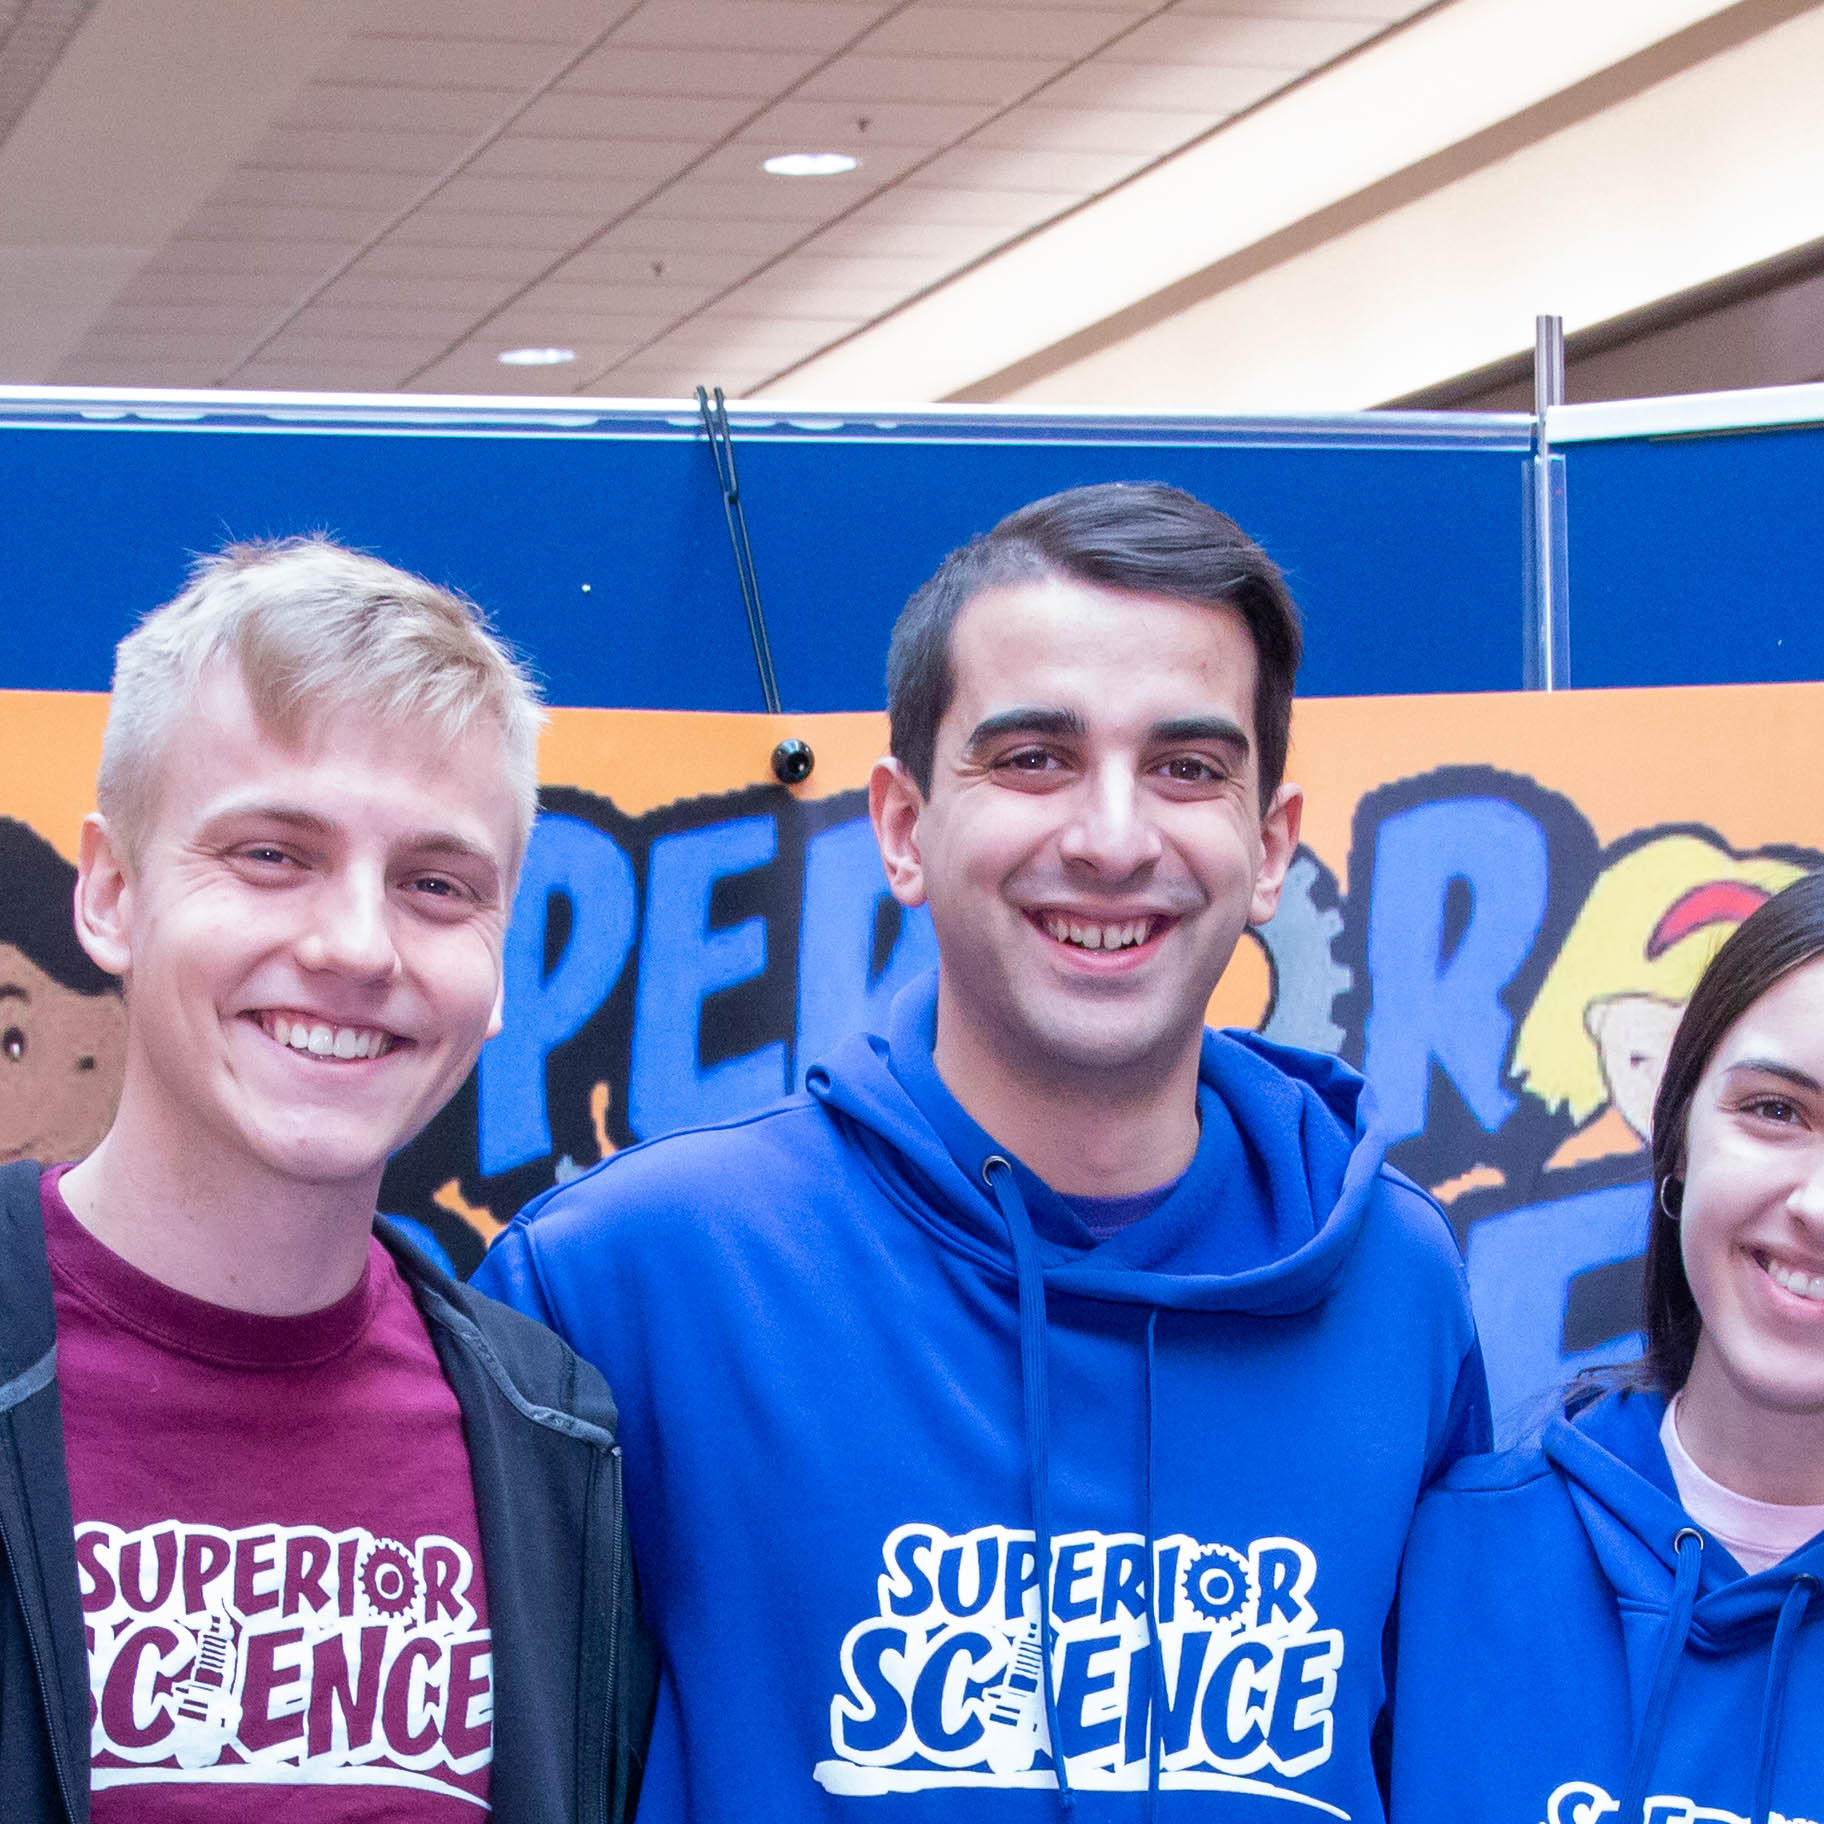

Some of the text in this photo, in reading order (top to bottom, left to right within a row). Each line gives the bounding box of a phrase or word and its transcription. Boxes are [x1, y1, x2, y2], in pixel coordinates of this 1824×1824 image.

[75, 1522, 473, 1628] SUPERIOR
[880, 1525, 1314, 1628] SUPERIOR
[85, 1620, 493, 1768] CIENCE
